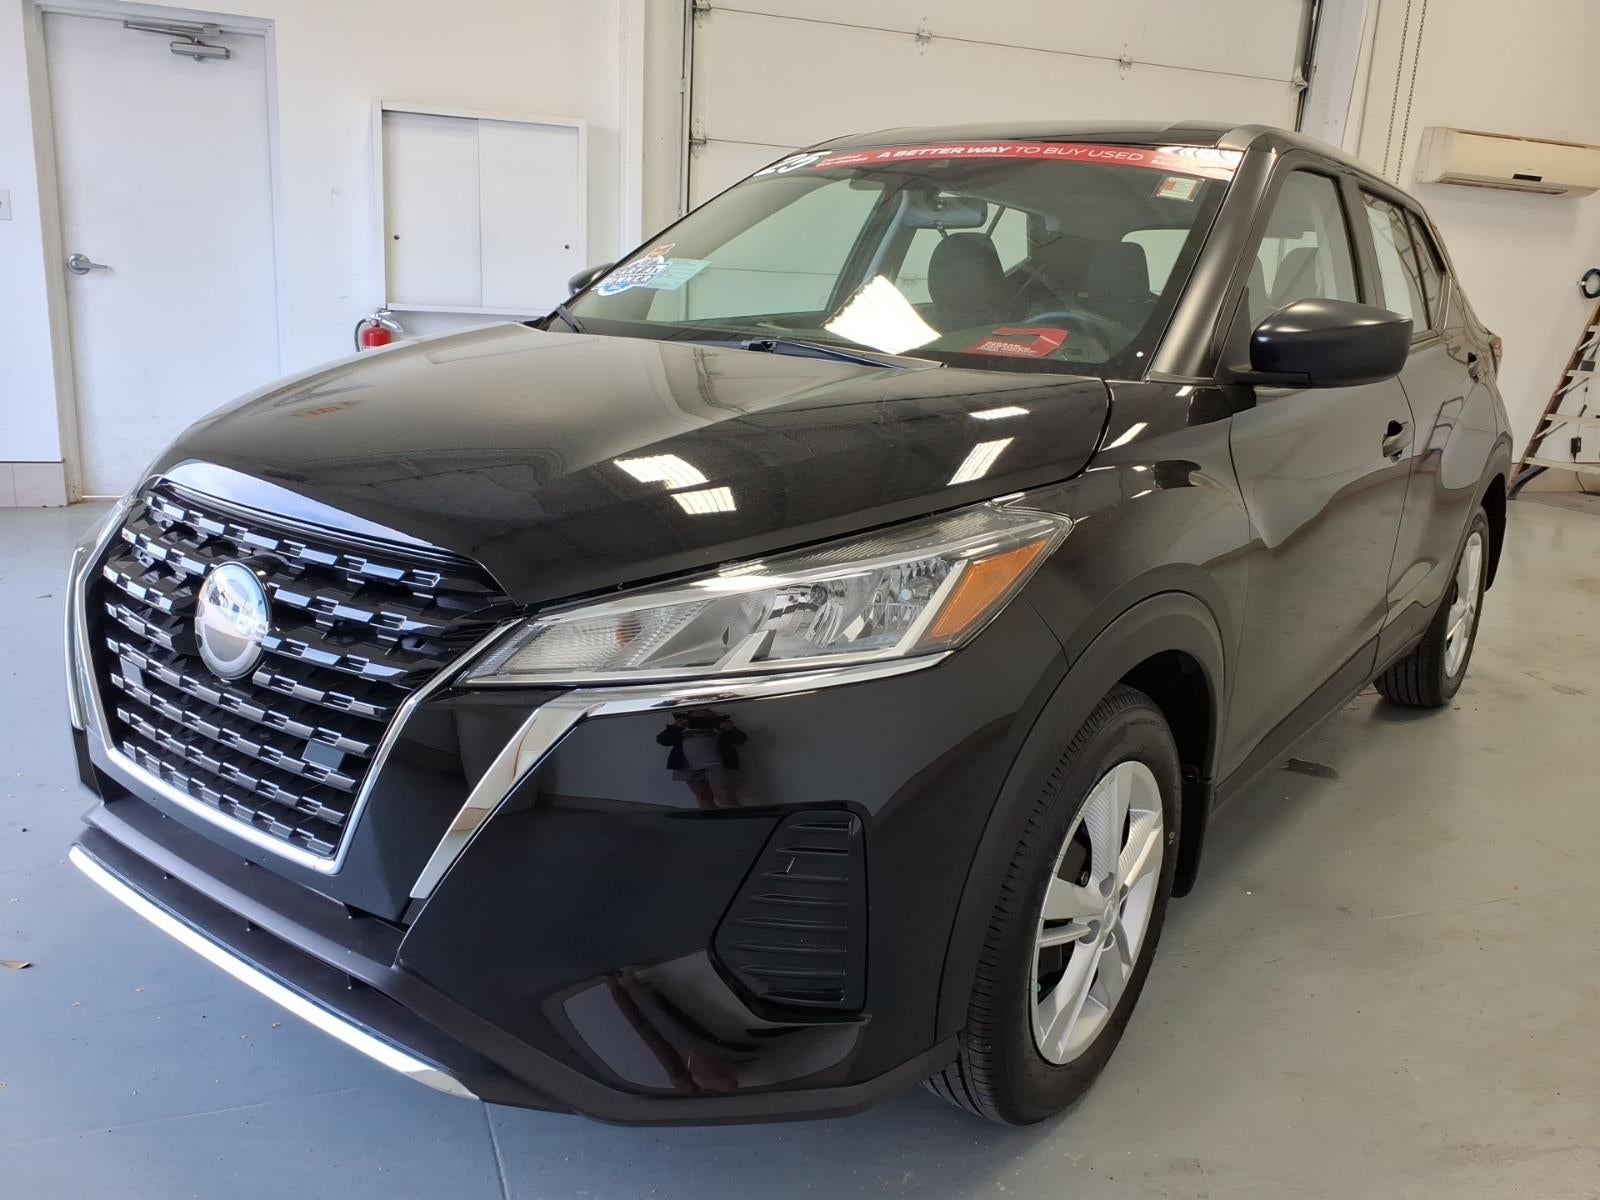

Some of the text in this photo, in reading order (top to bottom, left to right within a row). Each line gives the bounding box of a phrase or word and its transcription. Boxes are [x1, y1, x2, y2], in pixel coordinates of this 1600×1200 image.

[893, 147, 966, 158] BETTER
[967, 146, 1013, 154] WAY
[1016, 146, 1041, 154] TO
[1043, 147, 1088, 156] BUY
[1088, 149, 1144, 161] USED
